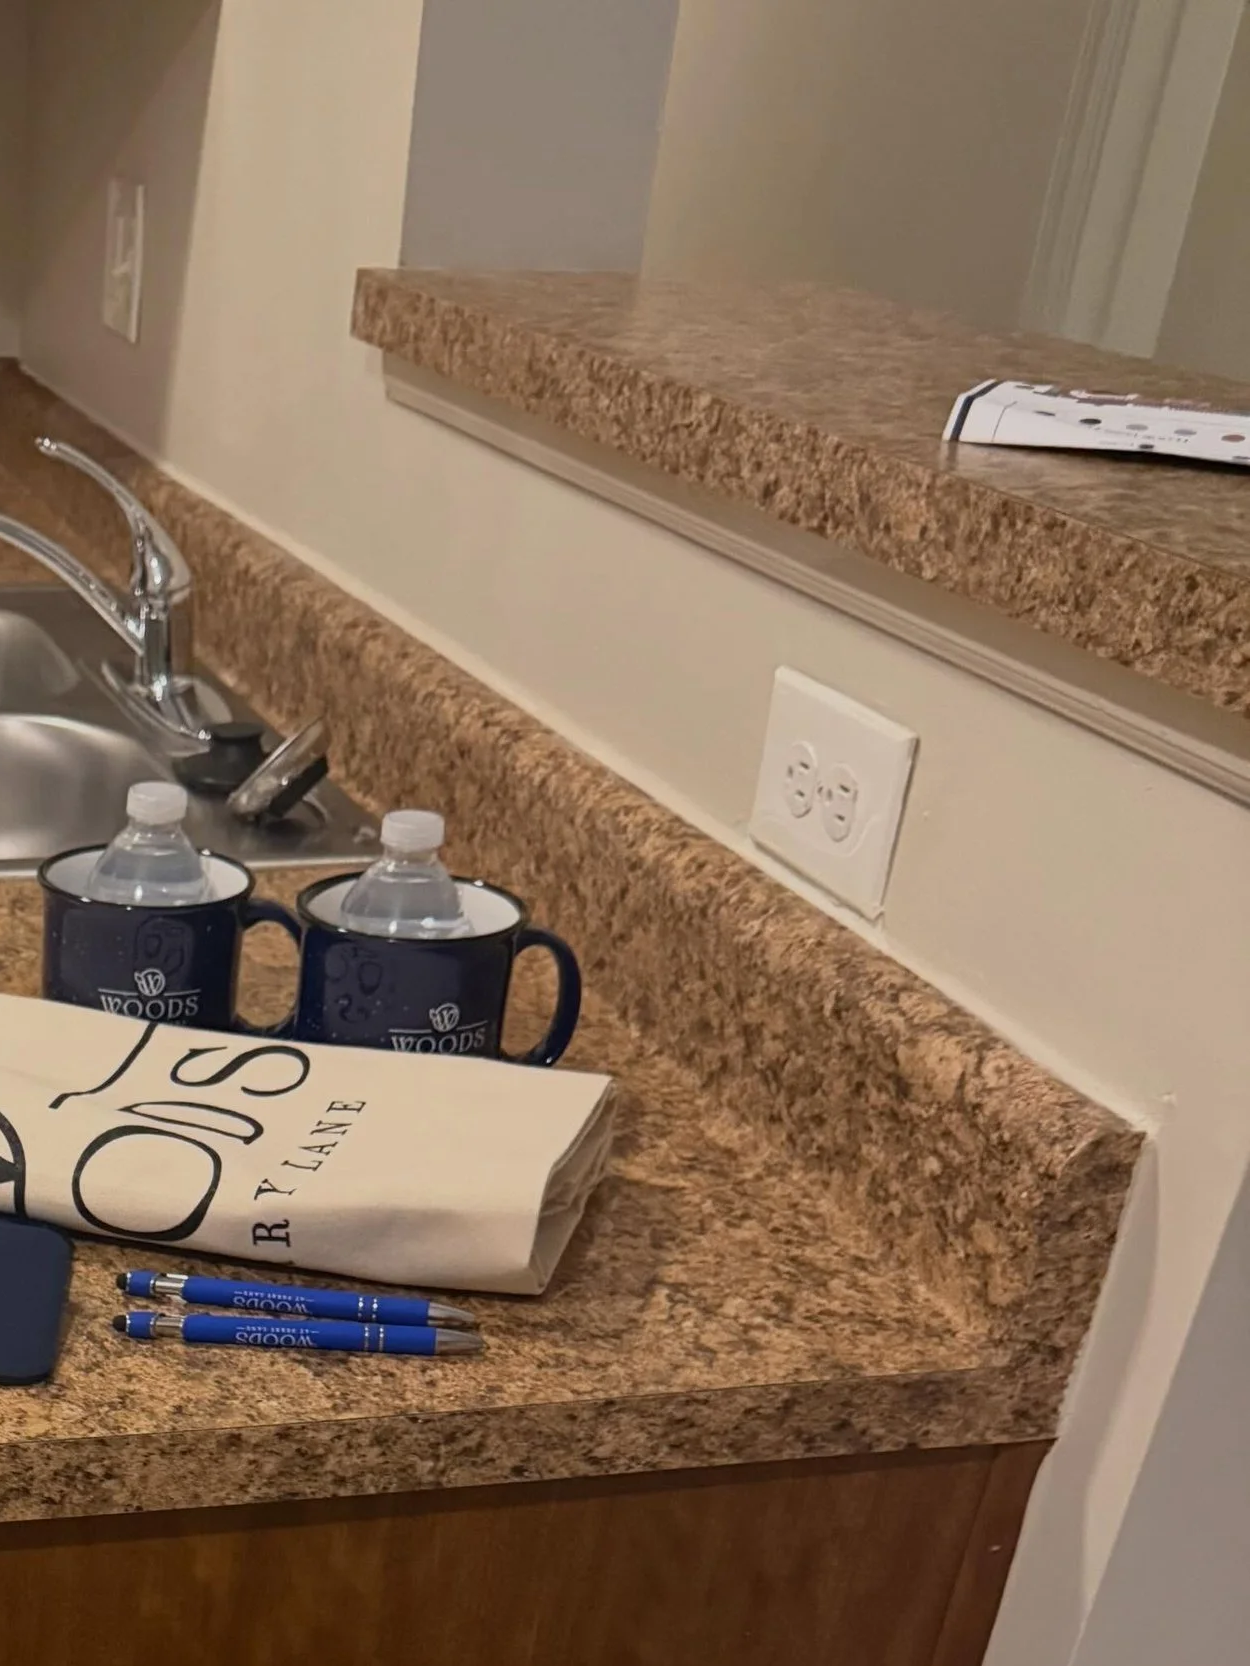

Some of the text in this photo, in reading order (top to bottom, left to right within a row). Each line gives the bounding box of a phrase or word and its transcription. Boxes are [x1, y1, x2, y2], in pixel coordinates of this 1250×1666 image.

[100, 995, 200, 1019] WOODS
[391, 1027, 486, 1053] WOODS
[72, 1045, 310, 1241] ODS
[252, 1100, 367, 1248] RY LANE
[233, 1296, 314, 1314] WOODS
[235, 1331, 317, 1347] WOODS
